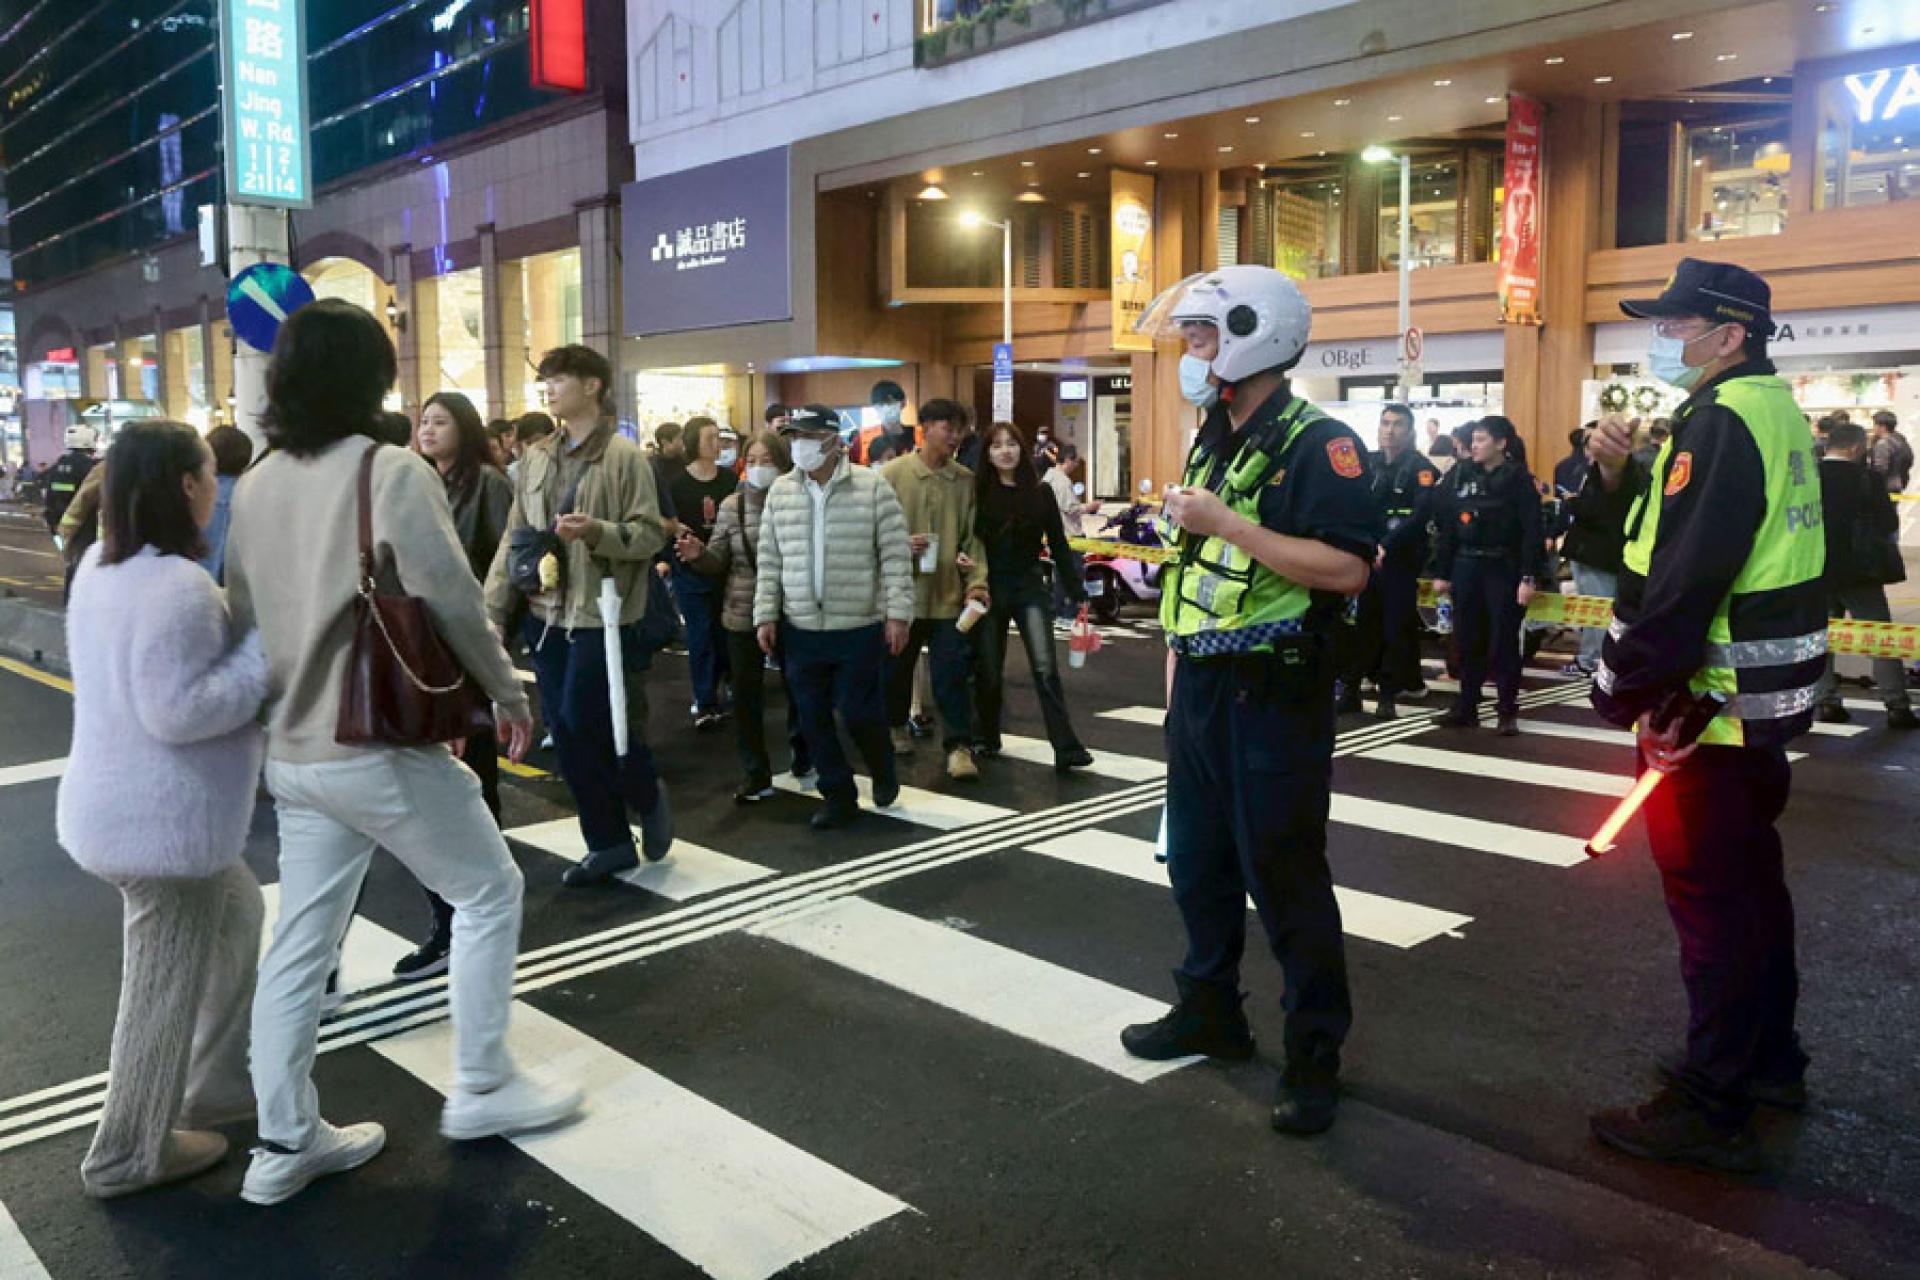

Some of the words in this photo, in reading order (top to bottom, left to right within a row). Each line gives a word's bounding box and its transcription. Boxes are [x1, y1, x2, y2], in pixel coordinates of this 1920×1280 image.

[244, 0, 282, 59] 路
[239, 61, 277, 86] Nan
[1844, 63, 1920, 122] YA
[241, 92, 282, 121] Jing
[241, 116, 263, 139] W.
[244, 172, 264, 190] 21
